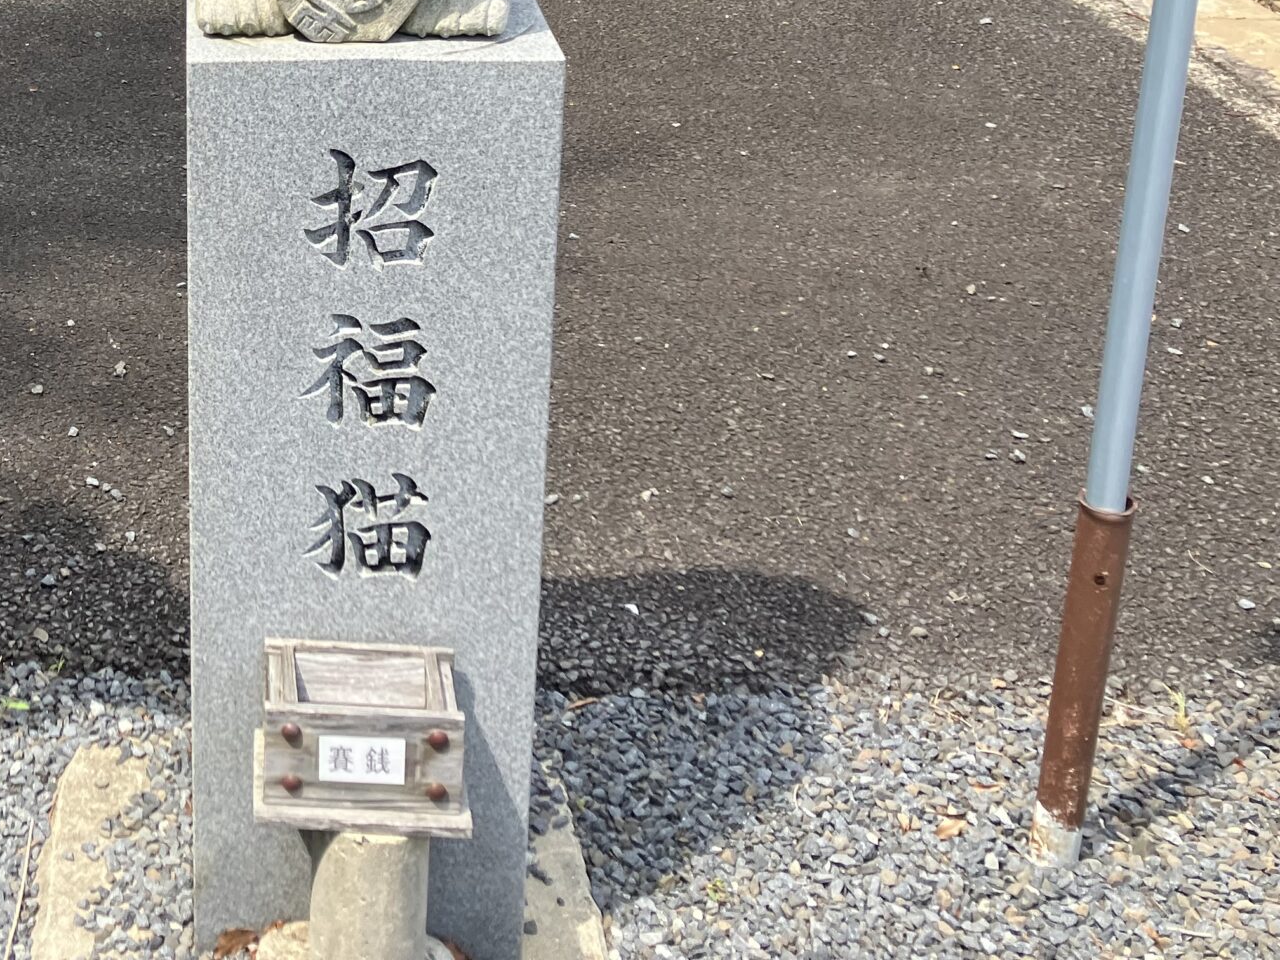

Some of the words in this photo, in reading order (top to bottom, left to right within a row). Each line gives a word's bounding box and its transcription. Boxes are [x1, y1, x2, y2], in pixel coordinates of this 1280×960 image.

[298, 148, 438, 581] 招福猫
[328, 744, 391, 775] 賽銭
